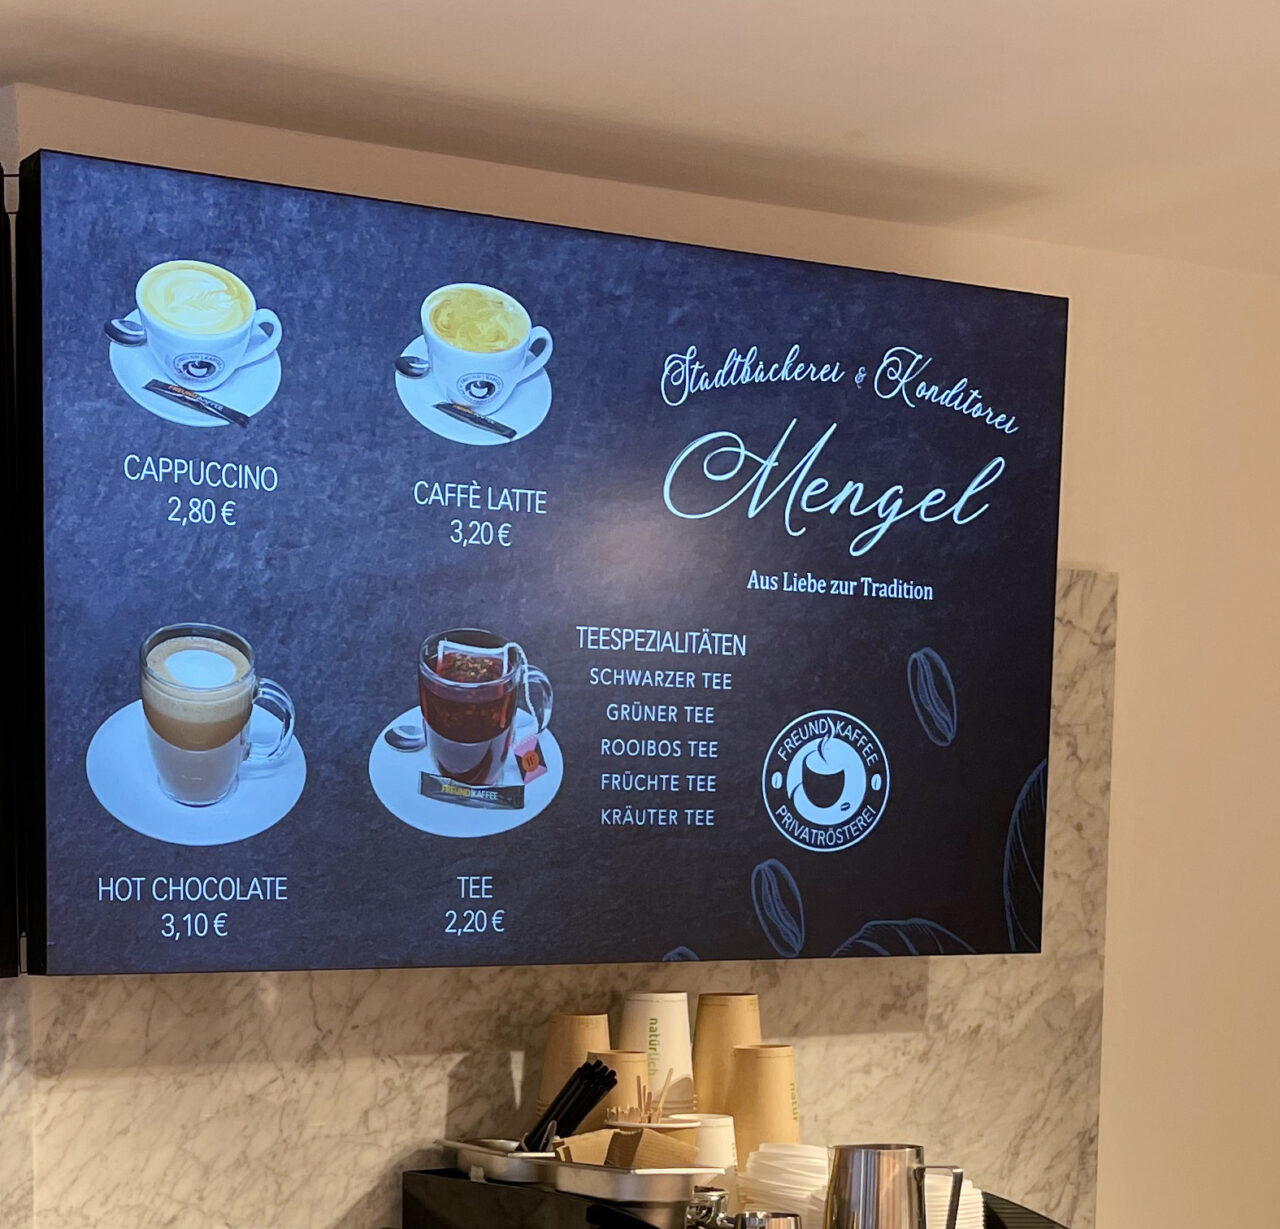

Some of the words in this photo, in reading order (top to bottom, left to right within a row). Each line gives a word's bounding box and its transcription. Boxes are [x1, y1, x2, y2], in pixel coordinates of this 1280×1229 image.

[661, 344, 845, 406] Stadtbäckerei
[854, 366, 867, 389] &
[874, 347, 1020, 434] Konditorei
[124, 454, 278, 492] CAPPUCCINO
[663, 418, 1005, 556] Mengel
[414, 480, 481, 510] CAFFÈ
[487, 486, 547, 514] LATTE
[168, 496, 216, 527] 2,80
[221, 501, 236, 526] €
[450, 519, 494, 547] 3,20
[498, 522, 512, 547] €
[747, 569, 778, 591] Aus
[783, 572, 825, 594] Liebe
[830, 580, 857, 595] zur
[861, 576, 934, 600] Tradition
[576, 625, 747, 656] TEESPEZIALITÄTEN
[589, 667, 695, 689] SCHWARZER
[702, 673, 732, 690] TEE
[606, 701, 678, 723] GRÜNER
[684, 706, 714, 723] TEE
[600, 738, 681, 757] ROOIBOS
[688, 740, 718, 758] TEE
[777, 719, 828, 762] FREUND
[835, 721, 879, 767] KAFFEE
[601, 771, 679, 791] FRÜCHTE
[686, 774, 716, 792] TEE
[601, 805, 678, 825] KRÄUTER
[685, 808, 715, 826] TEE
[775, 804, 877, 846] PRIVATRÖSTEREI
[98, 877, 145, 902] HOT
[151, 876, 287, 901] CHOCOLATE
[457, 876, 493, 899] TEE
[160, 913, 208, 939] 3,10
[213, 912, 228, 937] €
[445, 910, 487, 935] 2,20
[492, 909, 505, 933] €
